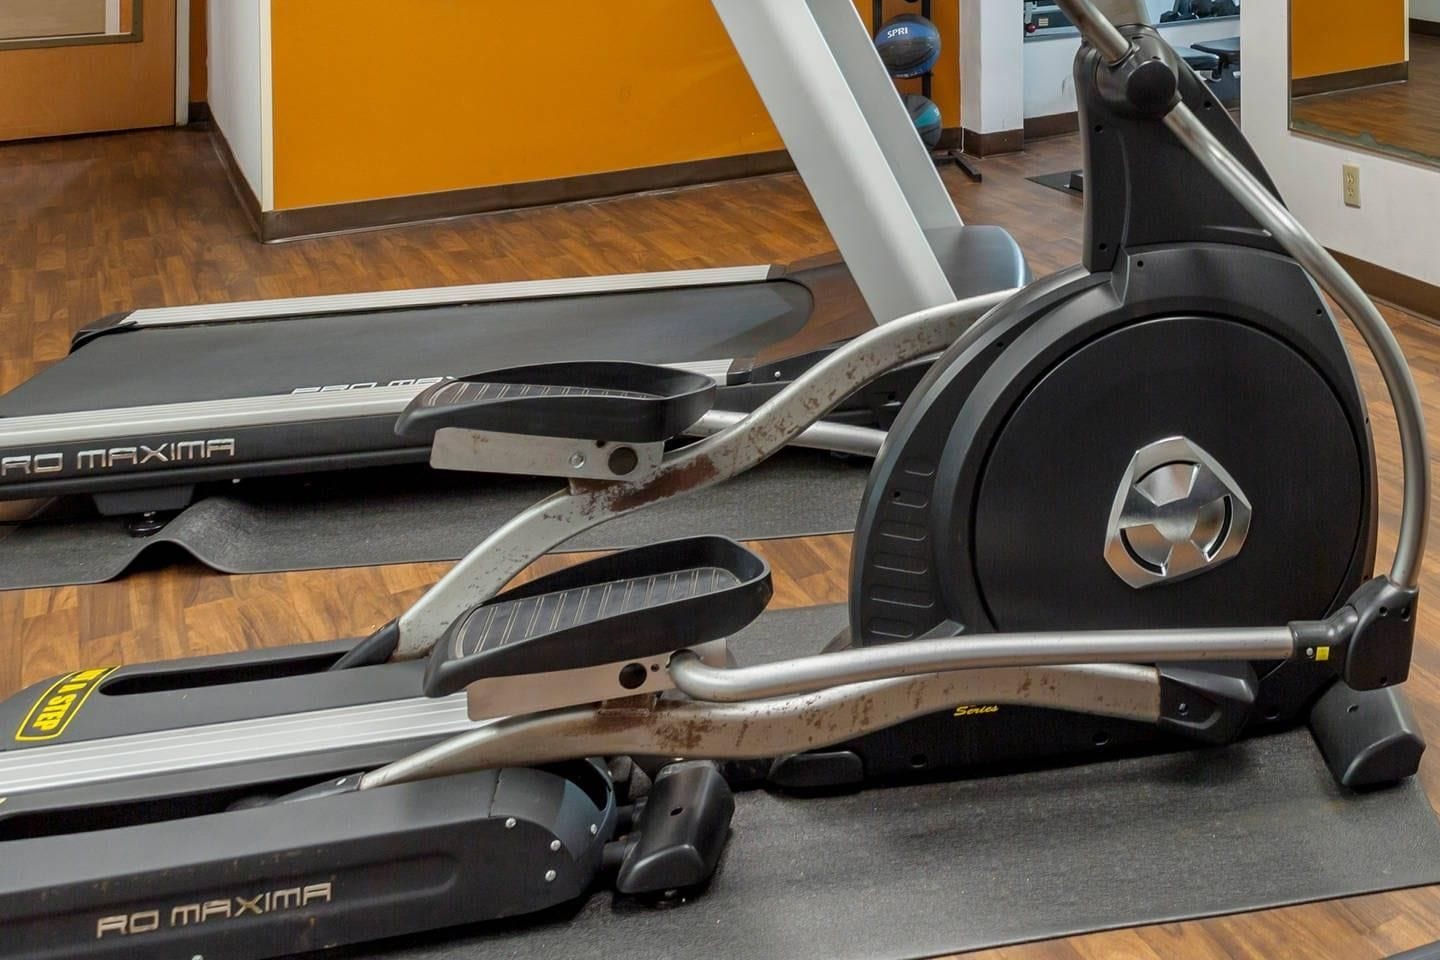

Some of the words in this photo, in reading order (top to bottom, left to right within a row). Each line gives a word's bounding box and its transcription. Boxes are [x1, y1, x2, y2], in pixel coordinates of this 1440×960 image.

[887, 26, 909, 39] SPRI
[77, 438, 235, 470] MAXIMA
[953, 704, 999, 717] Series
[170, 882, 332, 927] MAXIMA
